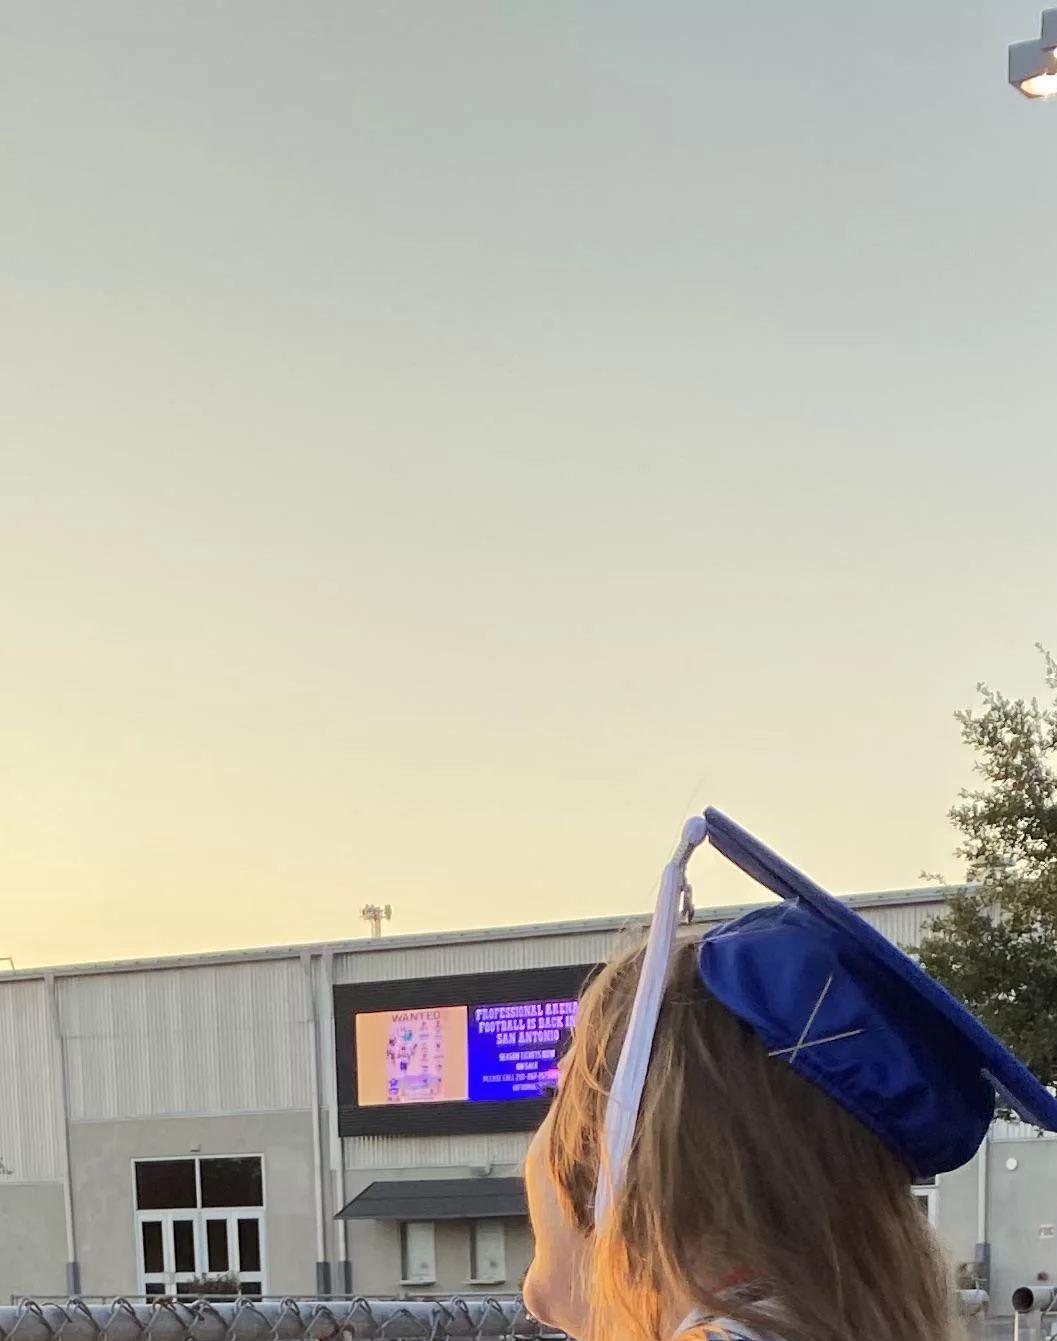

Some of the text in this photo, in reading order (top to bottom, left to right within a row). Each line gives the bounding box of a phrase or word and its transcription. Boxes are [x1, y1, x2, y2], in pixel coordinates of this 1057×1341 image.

[392, 1011, 440, 1022] WANTED
[475, 1004, 543, 1020] PROFESSIONAL
[479, 1018, 525, 1034] FOOTBALL
[527, 1018, 537, 1030] IS
[538, 1015, 564, 1029] BACK
[496, 1029, 560, 1045] SAN ANTONIO
